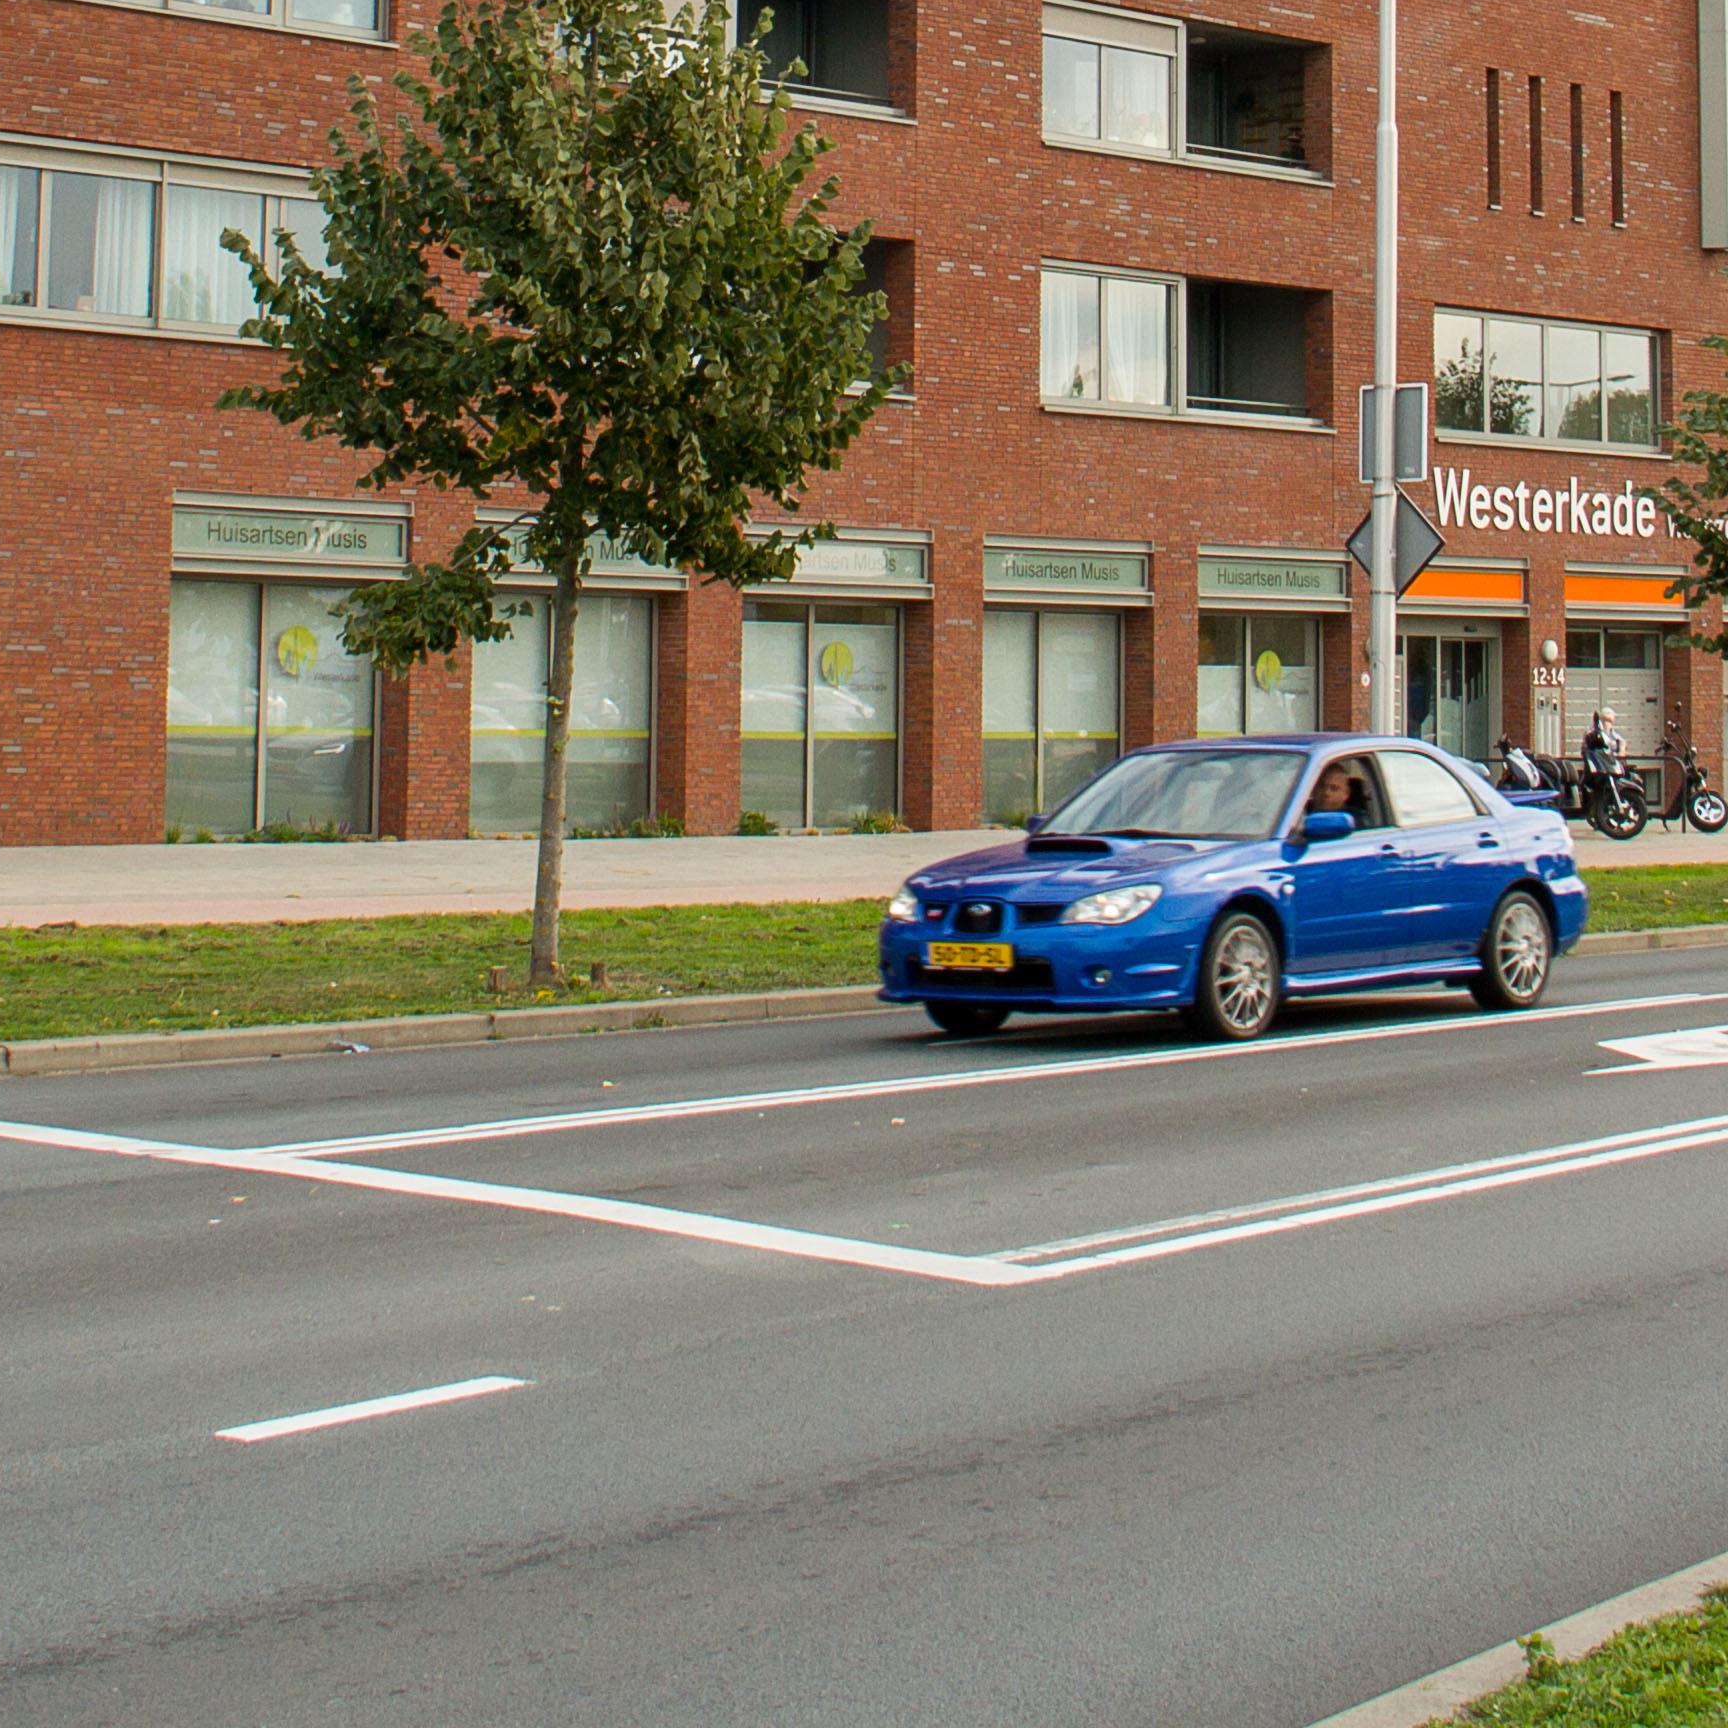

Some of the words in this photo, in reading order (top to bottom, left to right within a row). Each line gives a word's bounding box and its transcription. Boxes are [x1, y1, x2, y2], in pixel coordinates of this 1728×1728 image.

[1433, 467, 1656, 538] Westerkade
[207, 520, 308, 547] Huisartsen
[312, 525, 368, 550] Musis
[1004, 559, 1078, 580] Huisartsen
[1081, 562, 1121, 582] Musis
[1217, 567, 1282, 587] Huisartsen
[1285, 570, 1321, 589] Musis
